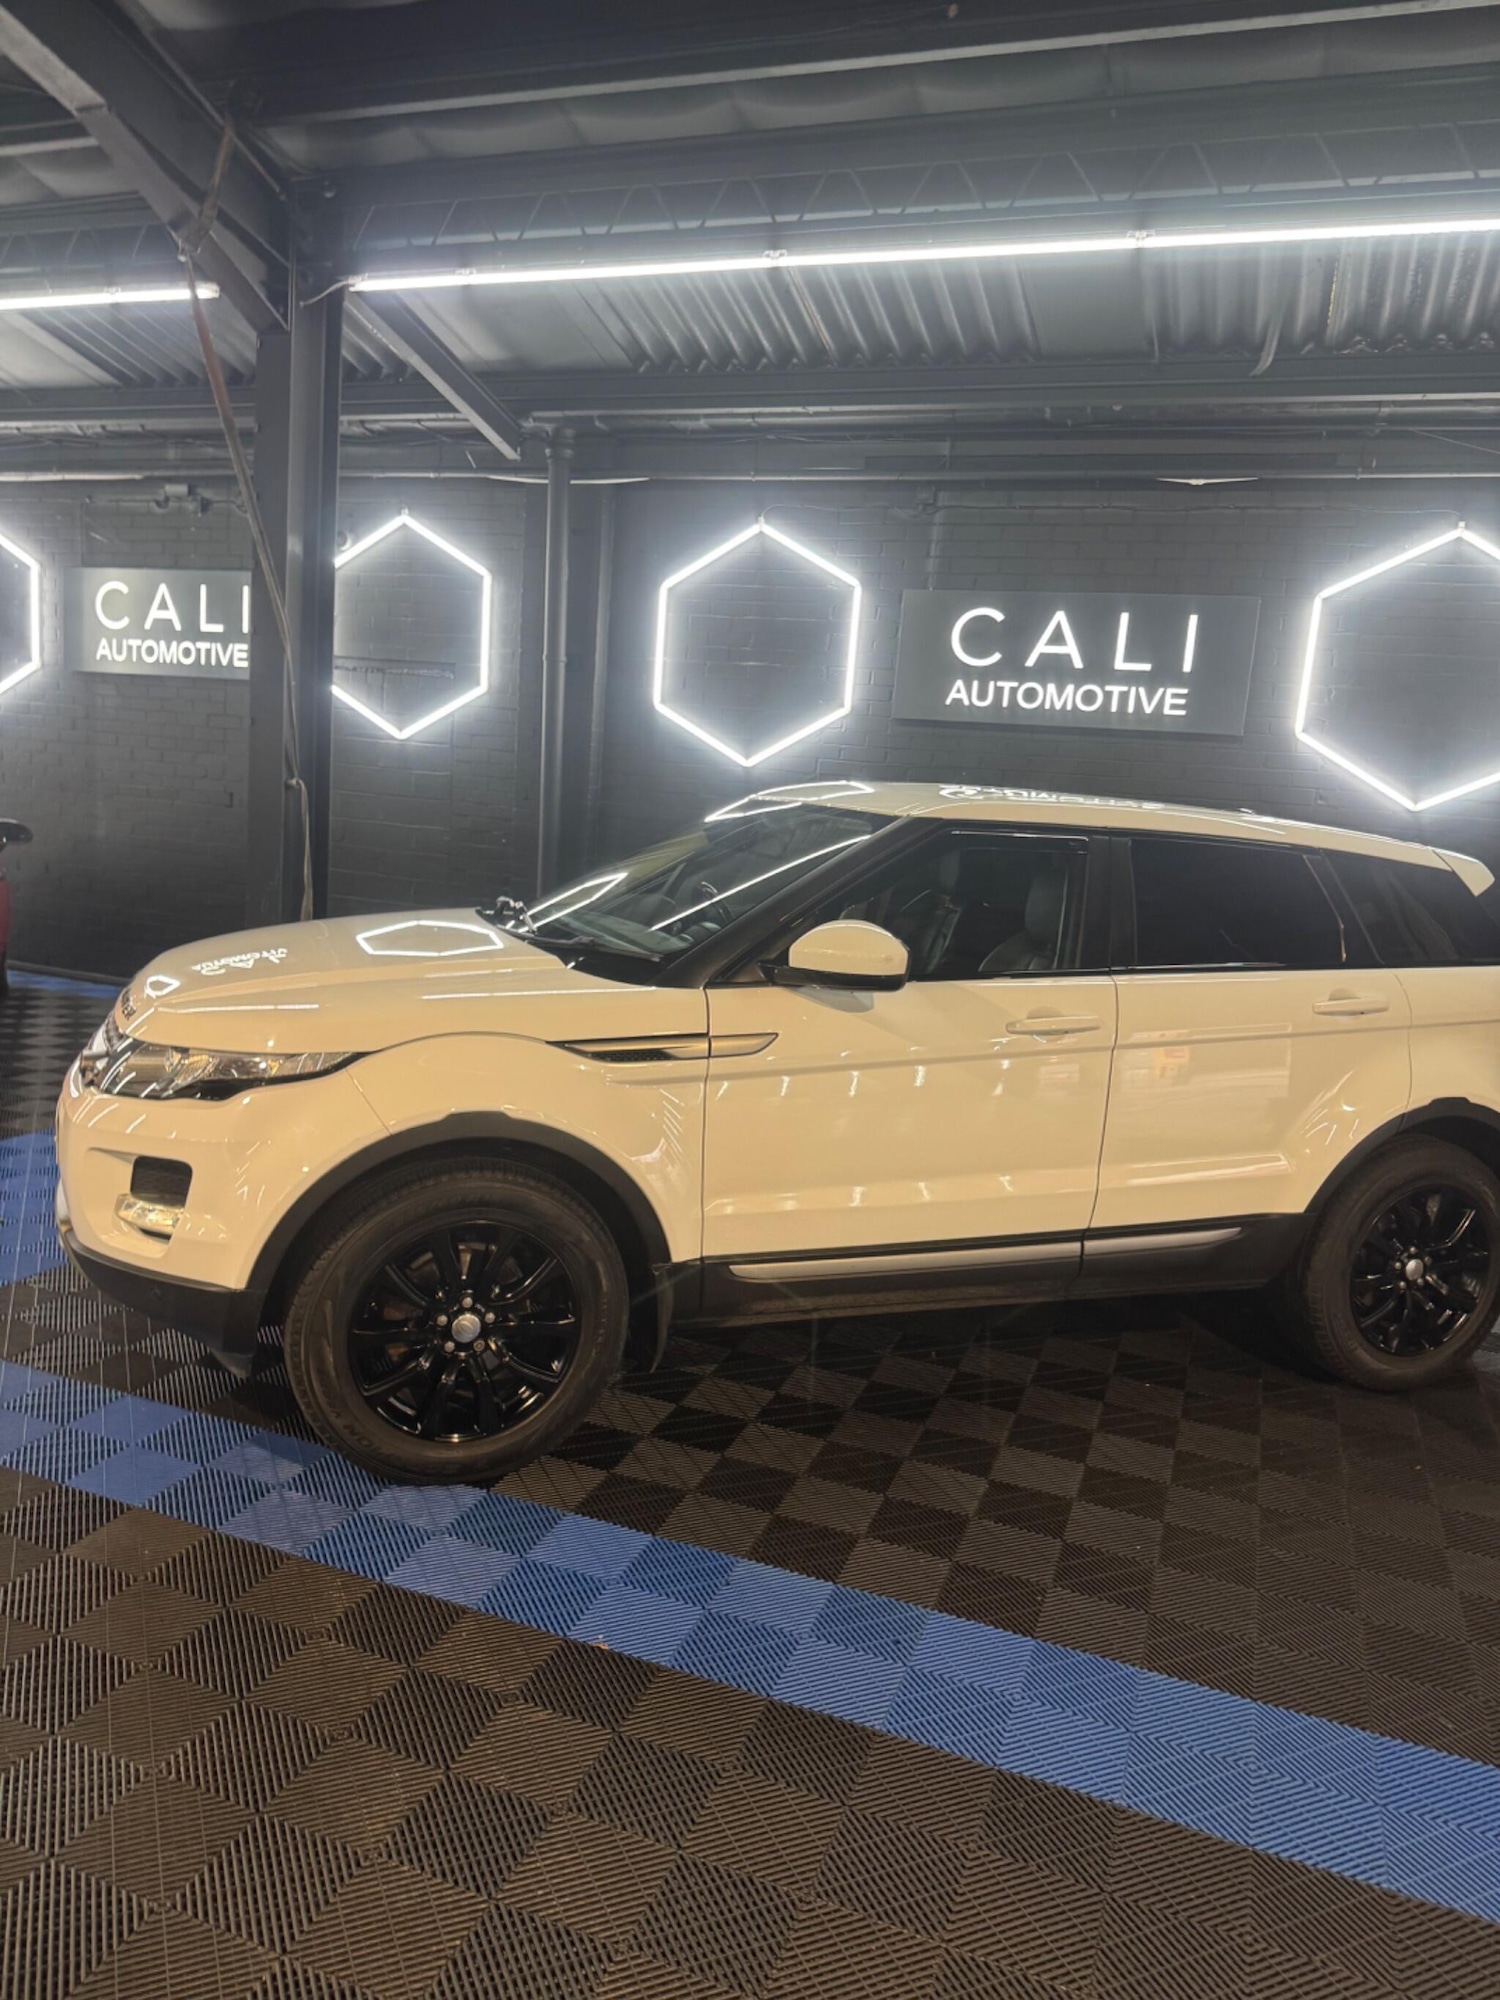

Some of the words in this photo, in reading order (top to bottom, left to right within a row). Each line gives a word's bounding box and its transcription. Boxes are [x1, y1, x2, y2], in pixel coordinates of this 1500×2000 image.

[95, 580, 249, 634] CALI
[96, 637, 249, 668] AUTOMOTIVE
[951, 607, 1199, 673] CALI
[945, 679, 1189, 716] AUTOMOTIVE
